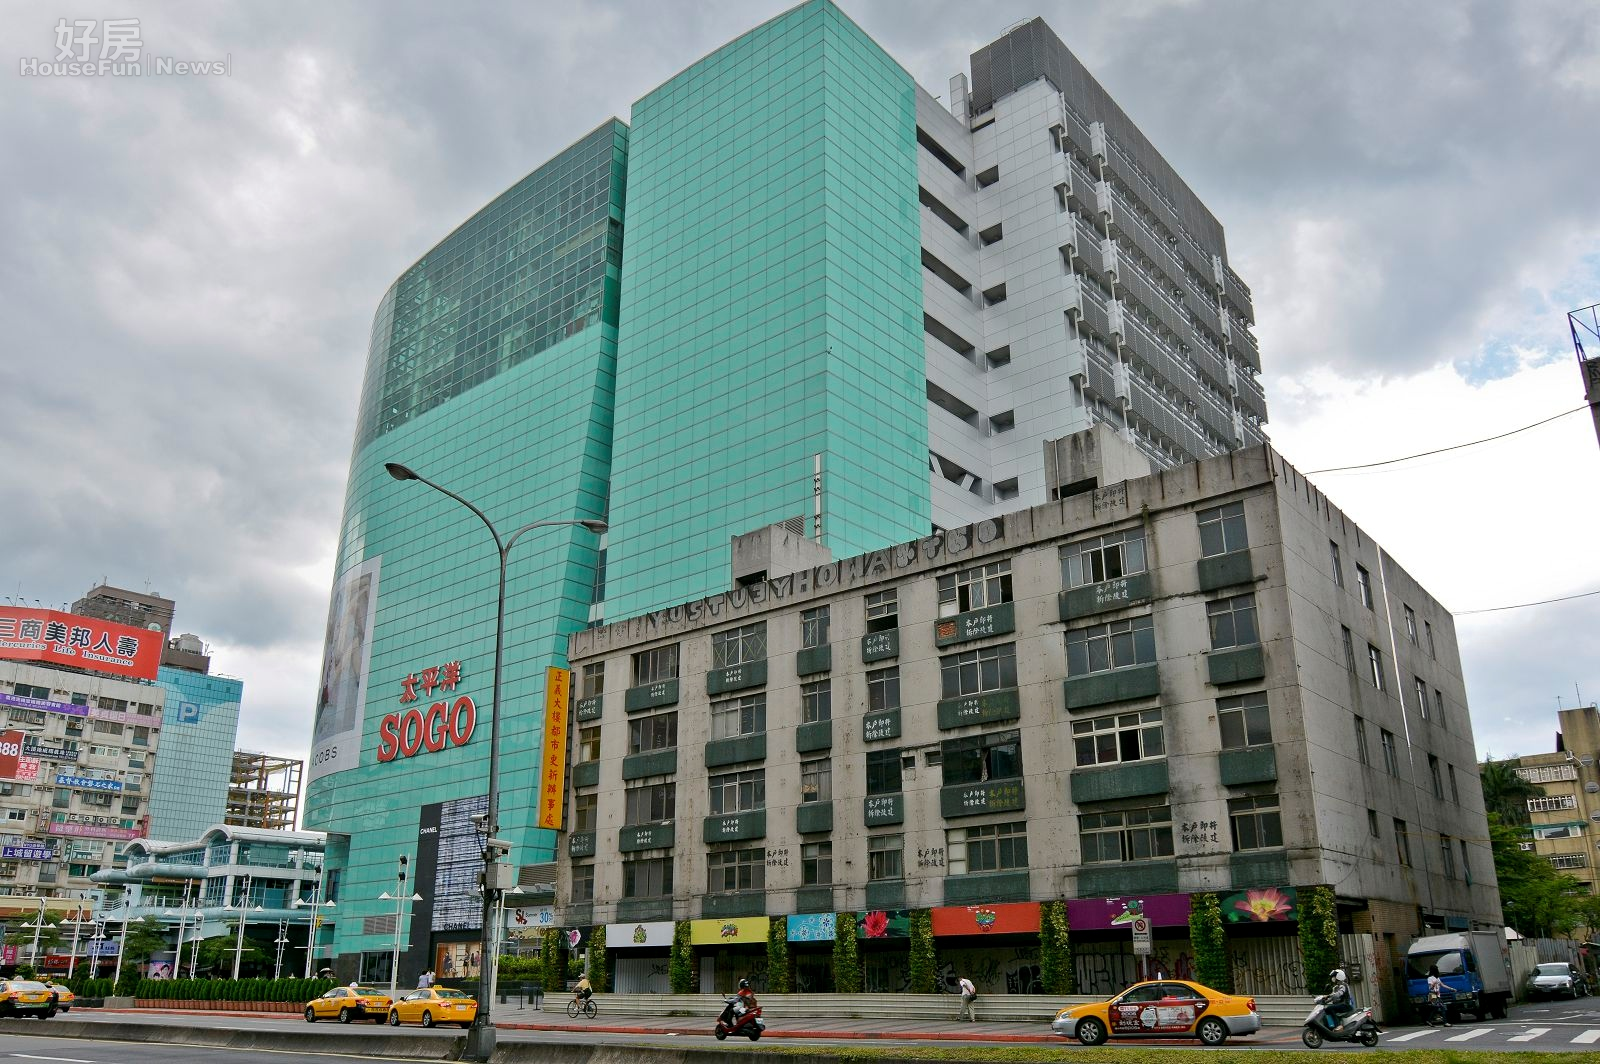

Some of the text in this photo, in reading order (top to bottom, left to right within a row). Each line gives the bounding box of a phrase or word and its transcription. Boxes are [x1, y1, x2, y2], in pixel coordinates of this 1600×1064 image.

[0, 618, 138, 657] 三商美邦人壽
[53, 644, 76, 655] Life
[82, 650, 134, 666] Insurance
[399, 660, 462, 703] 太平洋
[181, 704, 198, 721] P
[377, 696, 477, 763] SOGO
[420, 826, 438, 835] CHANEL
